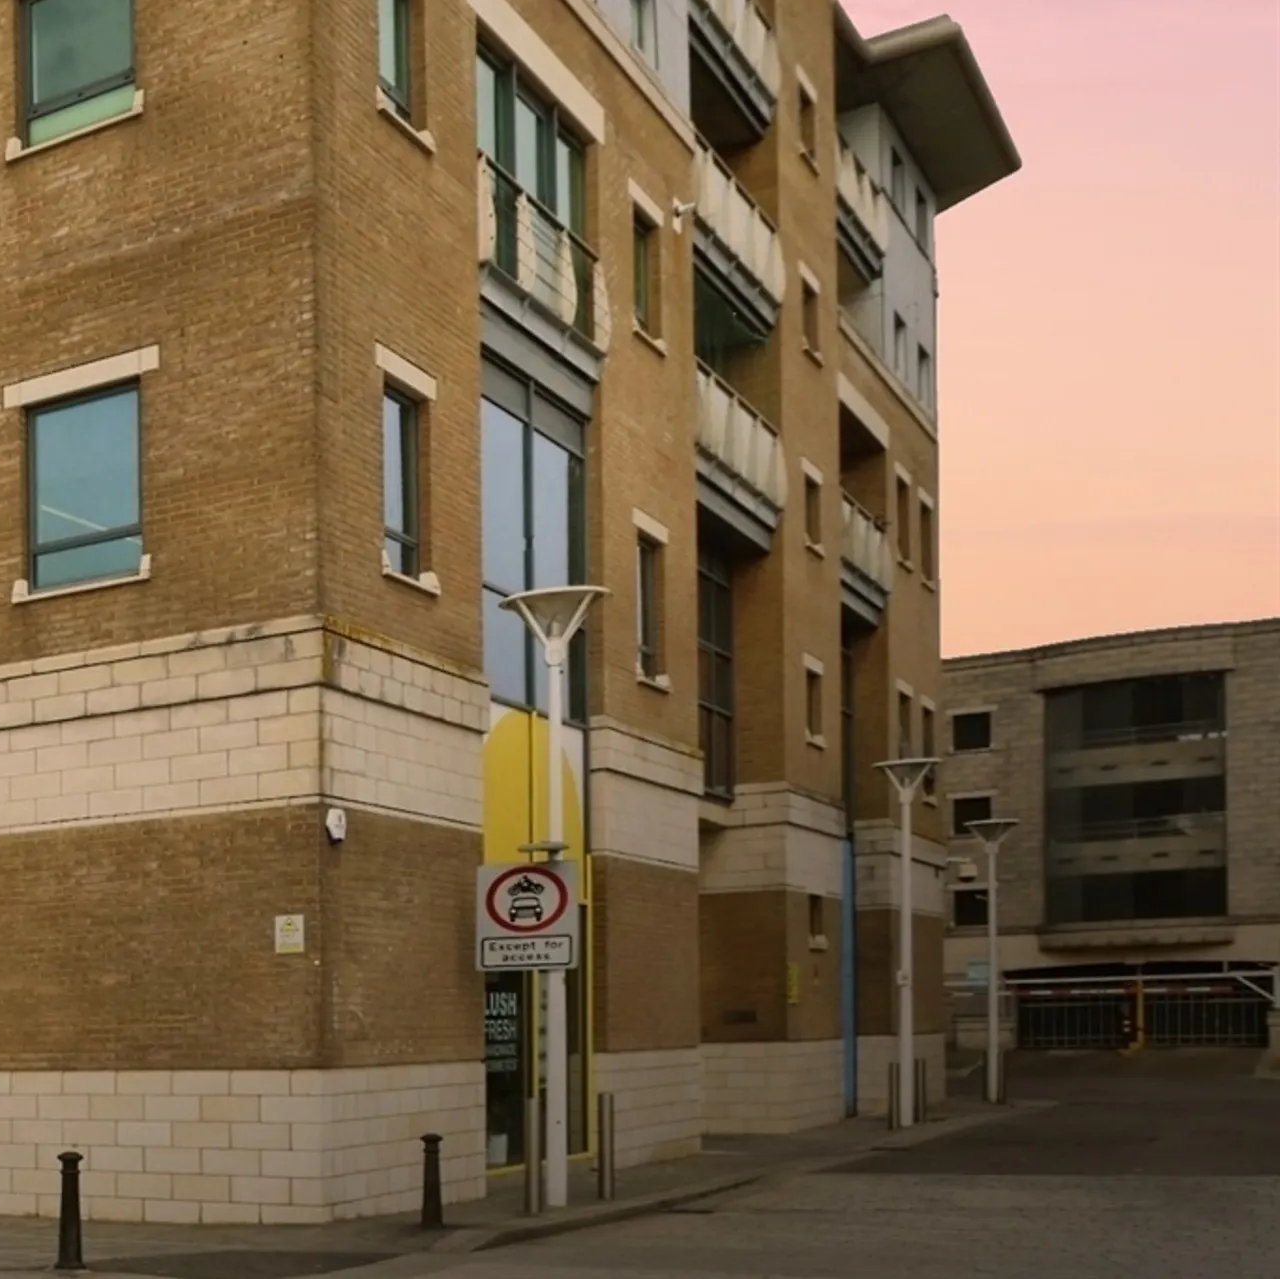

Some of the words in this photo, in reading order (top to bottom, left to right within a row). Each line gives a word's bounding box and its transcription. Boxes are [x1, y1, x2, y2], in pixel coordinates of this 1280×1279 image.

[489, 941, 536, 952] Except
[544, 940, 564, 949] for
[502, 953, 551, 962] access
